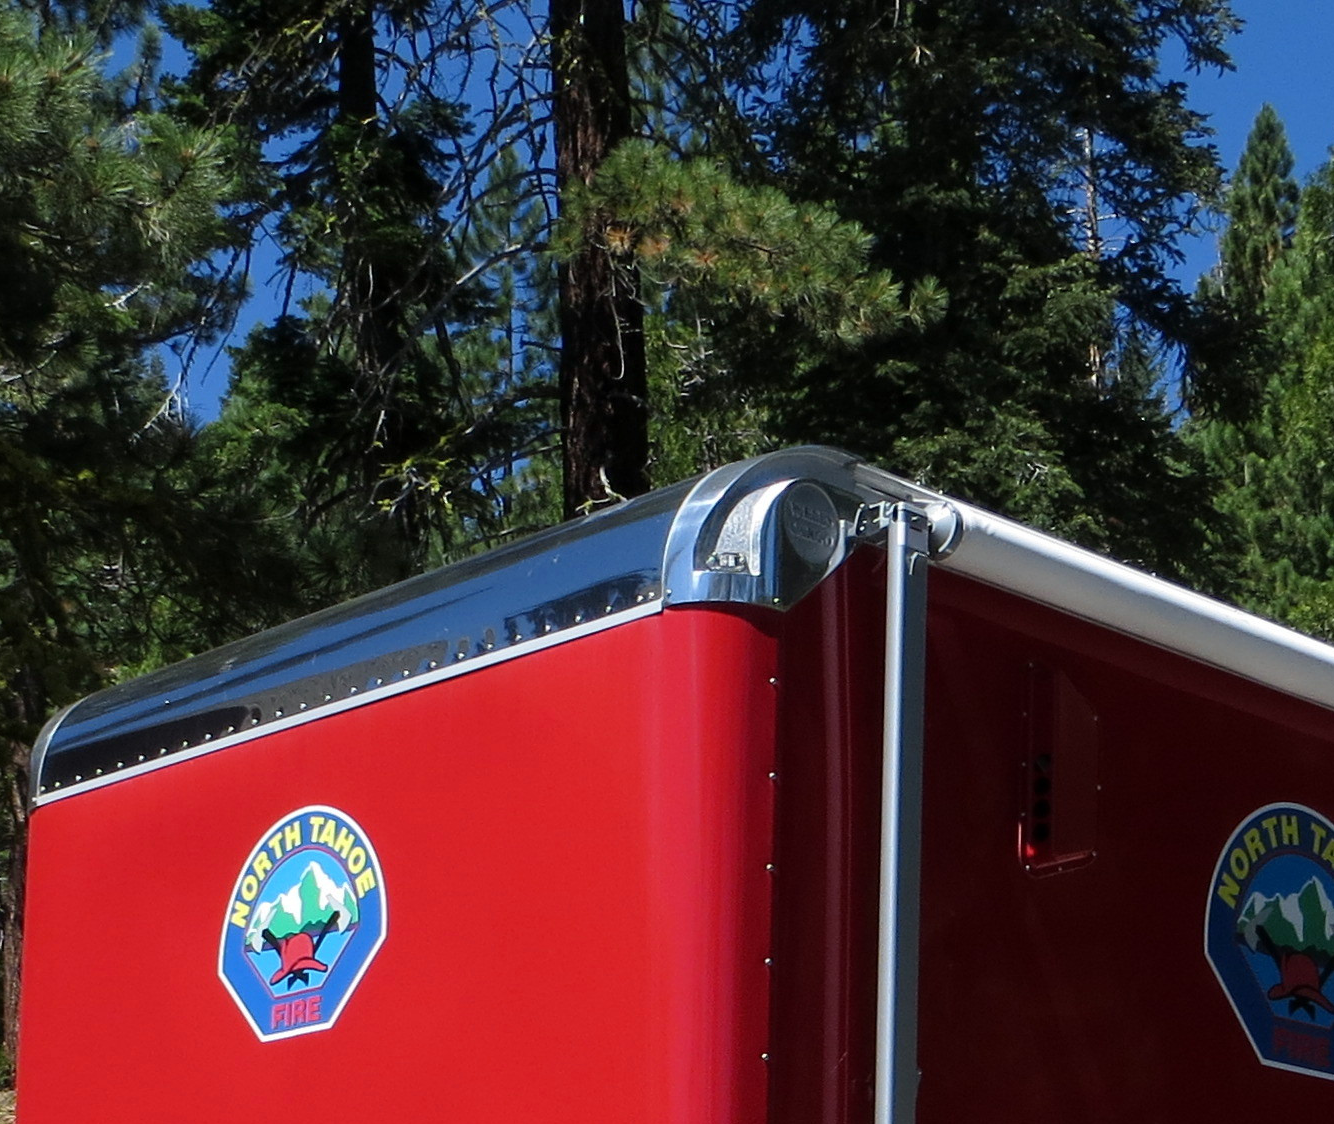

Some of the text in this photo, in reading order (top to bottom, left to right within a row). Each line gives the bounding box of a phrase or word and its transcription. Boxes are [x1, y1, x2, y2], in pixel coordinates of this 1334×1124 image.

[231, 815, 376, 928] NORTH TAHOE
[1217, 815, 1301, 909] NORTH
[270, 995, 323, 1030] FIRE
[1271, 1028, 1332, 1068] FIRE
